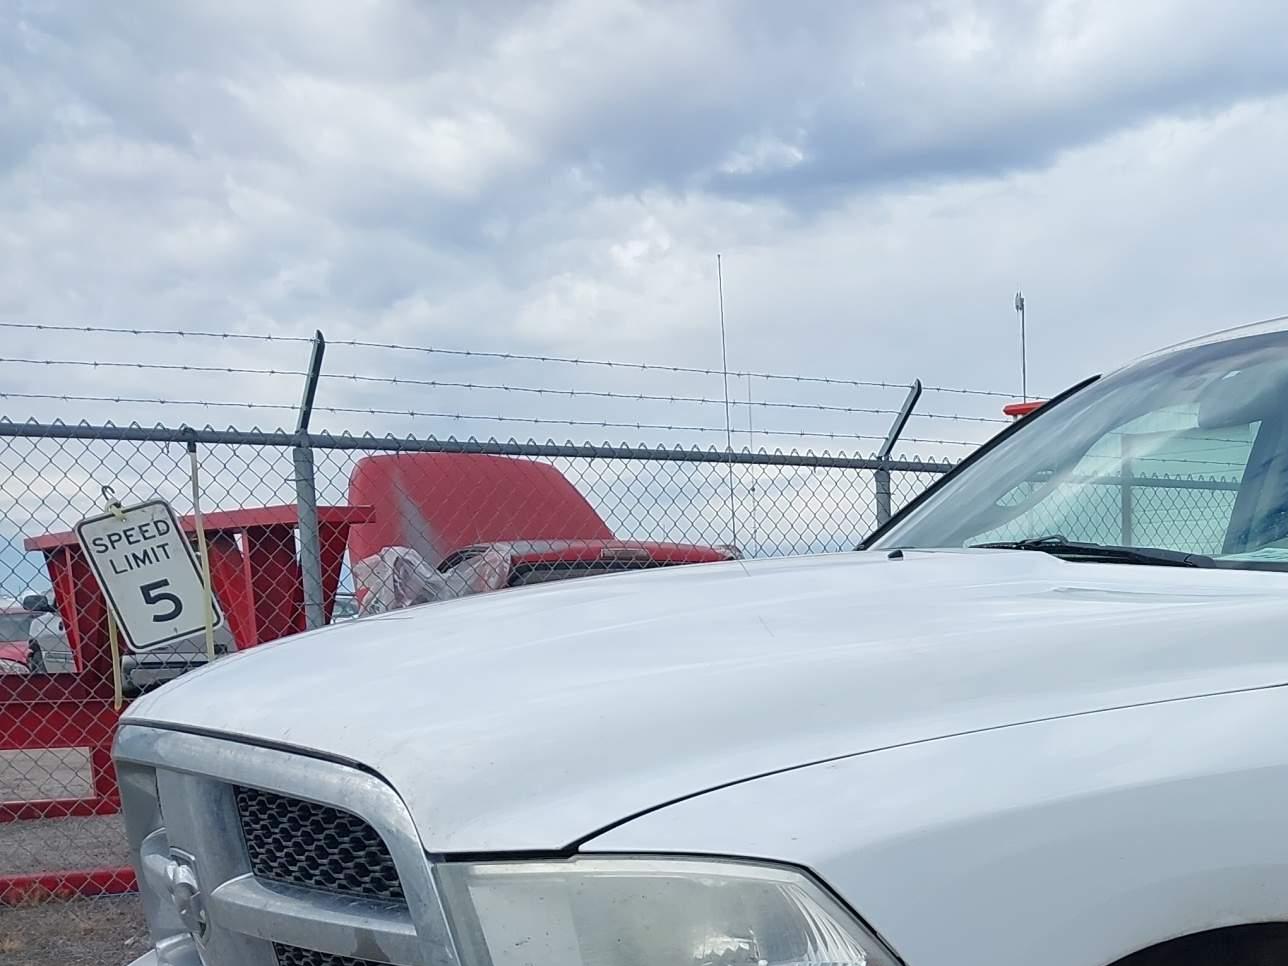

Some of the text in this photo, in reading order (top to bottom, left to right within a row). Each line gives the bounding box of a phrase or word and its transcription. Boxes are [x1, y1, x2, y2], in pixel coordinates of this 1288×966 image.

[92, 519, 170, 554] SPEED
[109, 542, 171, 575] LIMIT
[140, 578, 183, 622] 5
